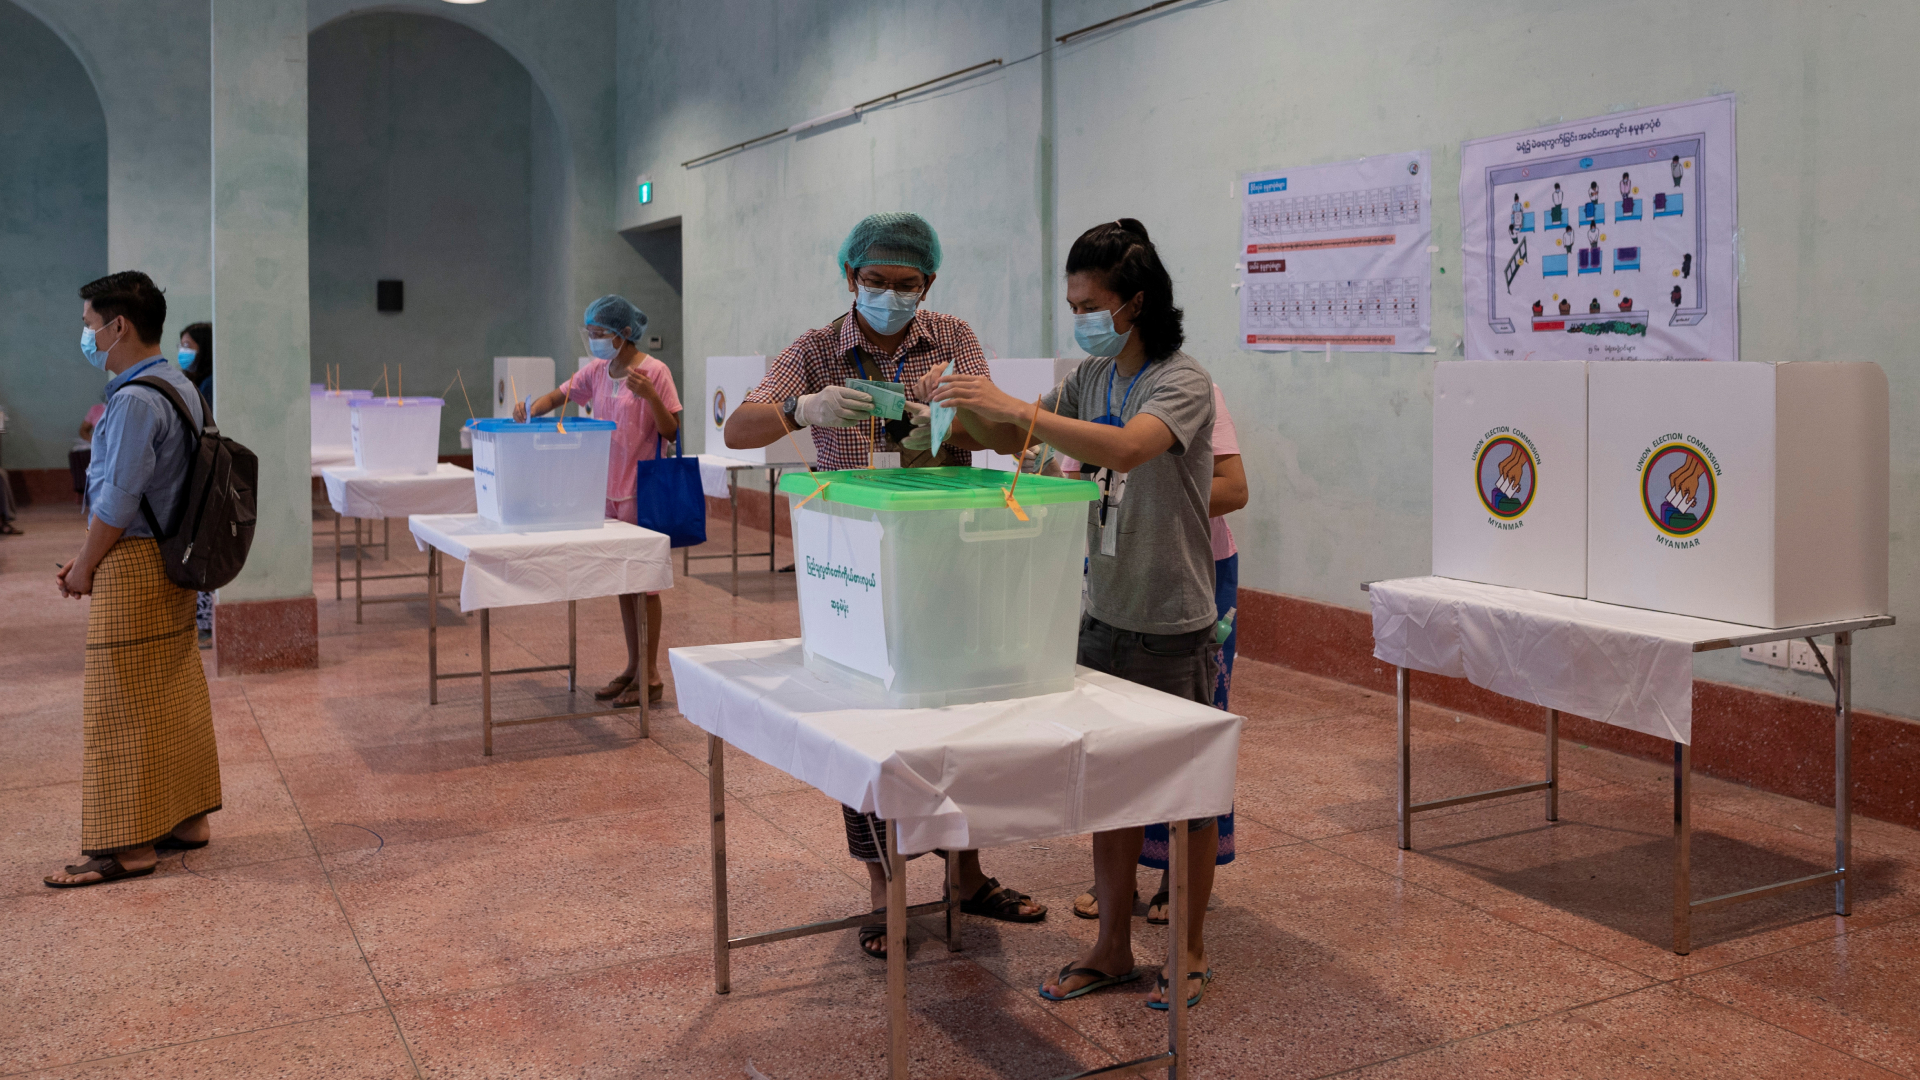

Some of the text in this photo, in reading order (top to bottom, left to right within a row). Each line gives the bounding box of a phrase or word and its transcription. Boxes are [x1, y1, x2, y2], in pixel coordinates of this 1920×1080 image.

[1471, 426, 1542, 466] UNION ELECTION COMMISSION
[1635, 432, 1723, 476] UNION ELECTION COMMISSION
[1487, 516, 1524, 531] MYANMAR
[1655, 534, 1701, 549] MYANMAR
